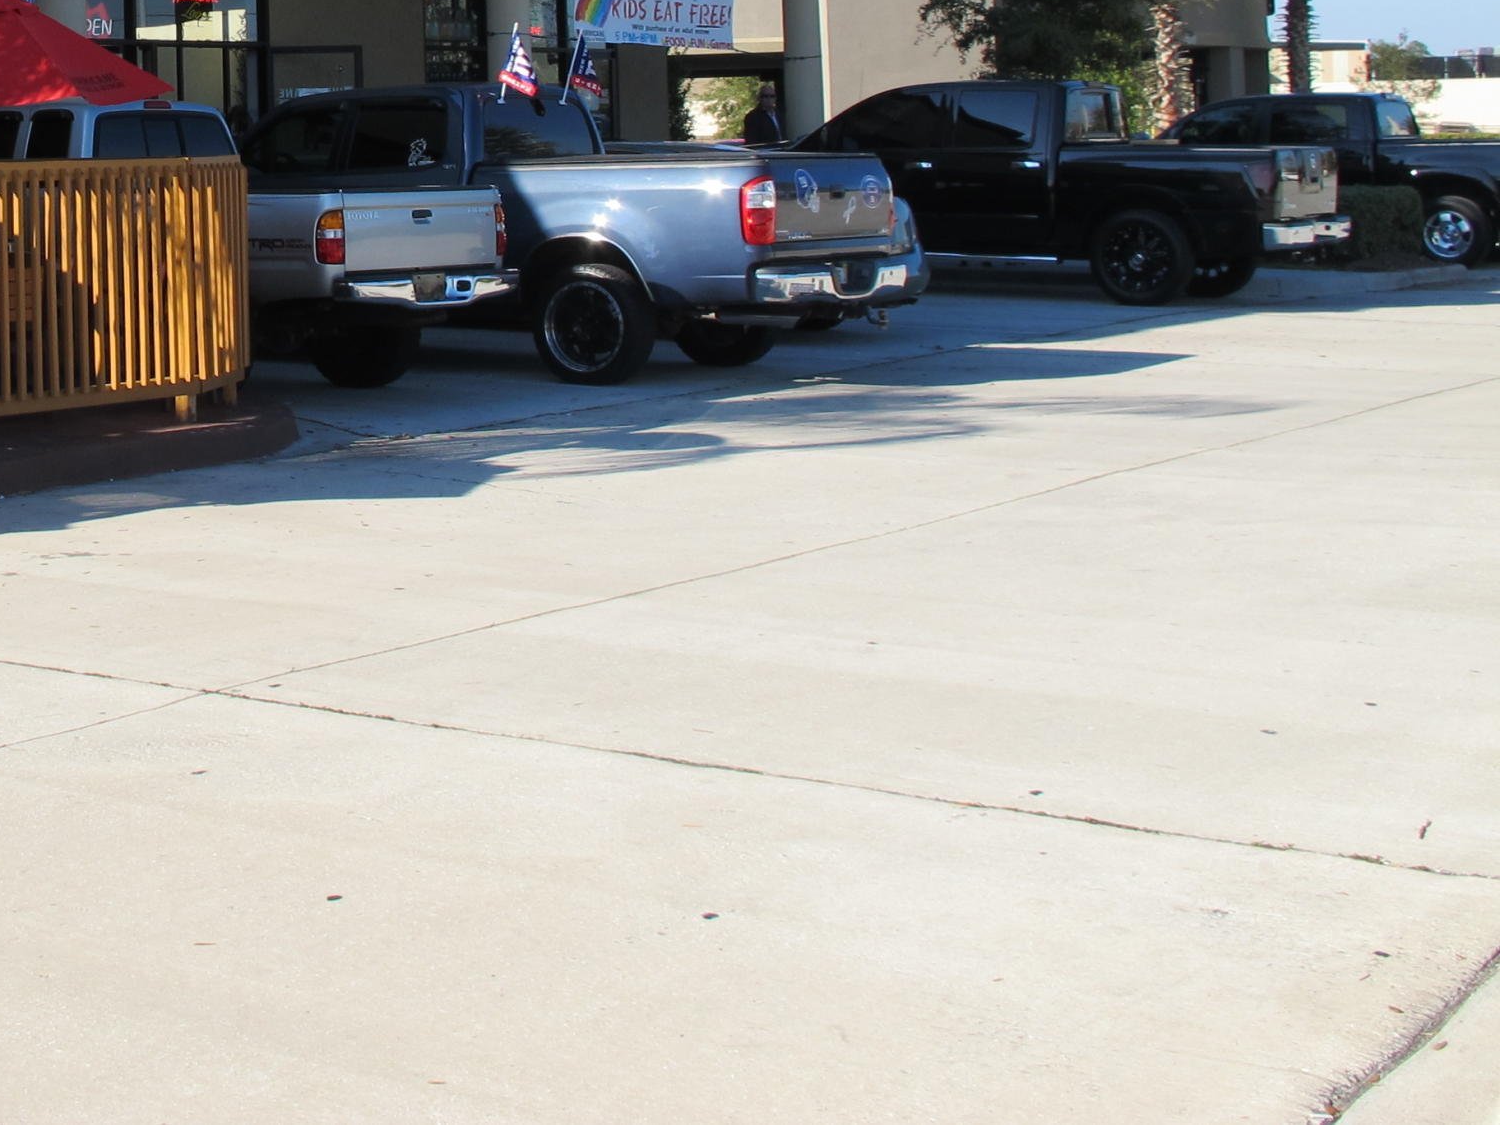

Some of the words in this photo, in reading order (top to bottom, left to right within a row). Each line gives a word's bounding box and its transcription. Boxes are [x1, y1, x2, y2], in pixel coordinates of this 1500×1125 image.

[653, 0, 683, 24] EAT
[689, 3, 732, 25] FREE!
[664, 36, 686, 47] FOOD
[347, 211, 379, 220] TOYOTA
